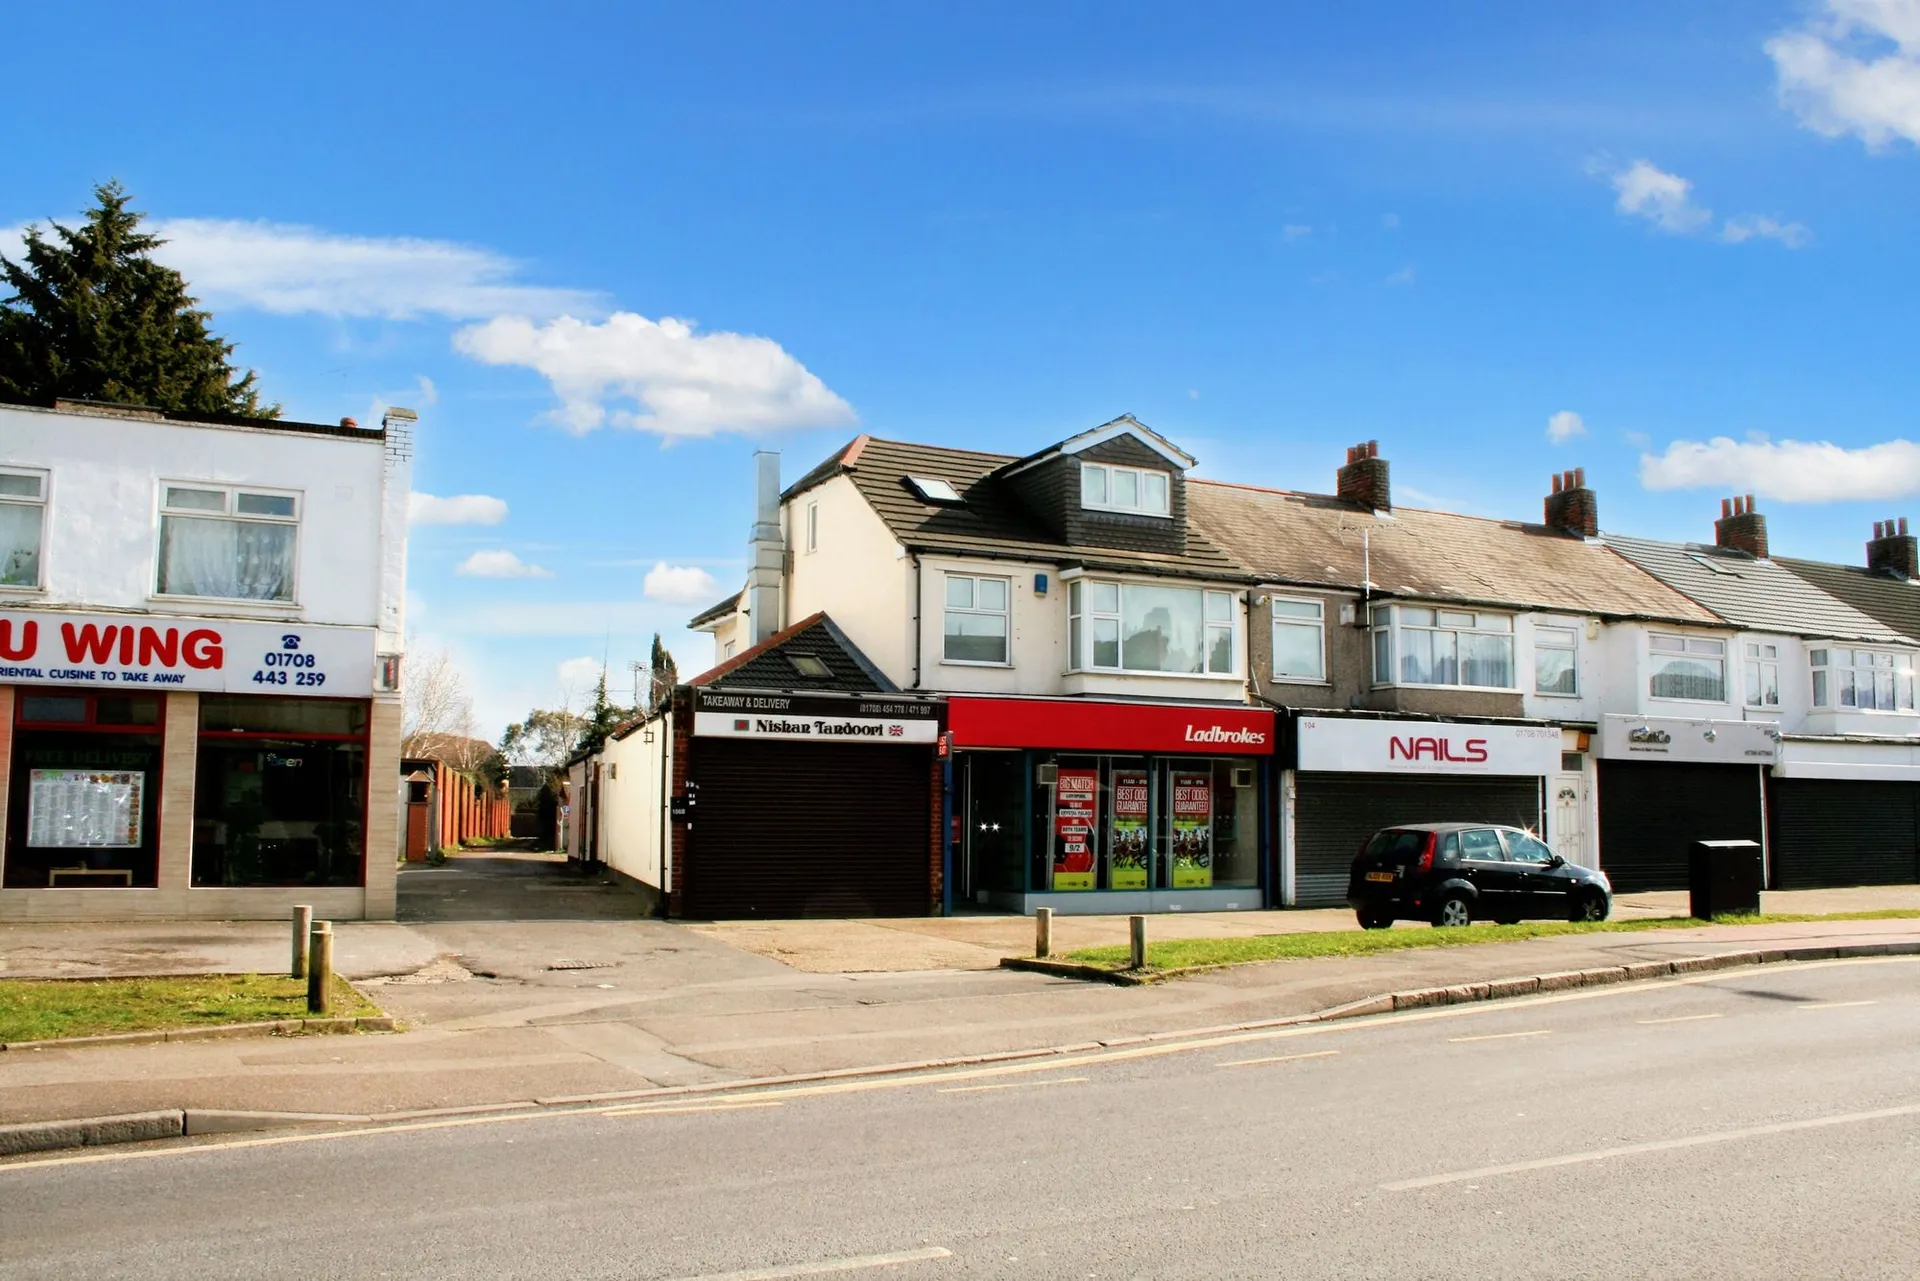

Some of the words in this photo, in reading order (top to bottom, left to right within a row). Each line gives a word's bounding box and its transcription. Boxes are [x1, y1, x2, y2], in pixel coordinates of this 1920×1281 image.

[0, 619, 38, 661] U
[61, 622, 224, 670] WING
[264, 652, 316, 668] 01708
[49, 669, 96, 680] CUISINE
[101, 671, 117, 681] TO
[122, 671, 149, 682] TAKE
[153, 673, 186, 684] AWAY
[252, 670, 288, 685] 443
[295, 672, 326, 687] 259
[702, 695, 745, 707] TAKEAWAY
[745, 697, 752, 708] &
[753, 698, 791, 709] DELIVERY
[756, 719, 811, 735] Nishan
[814, 720, 883, 737] Tandoori
[1184, 724, 1266, 744] Ladbrokes
[1389, 735, 1488, 763] NAILS
[1117, 788, 1133, 800] BEST
[1175, 788, 1191, 800] BEST
[1191, 789, 1209, 801] ODDS
[1175, 800, 1209, 811] GUARANTEED
[1069, 844, 1081, 852] 9/2
